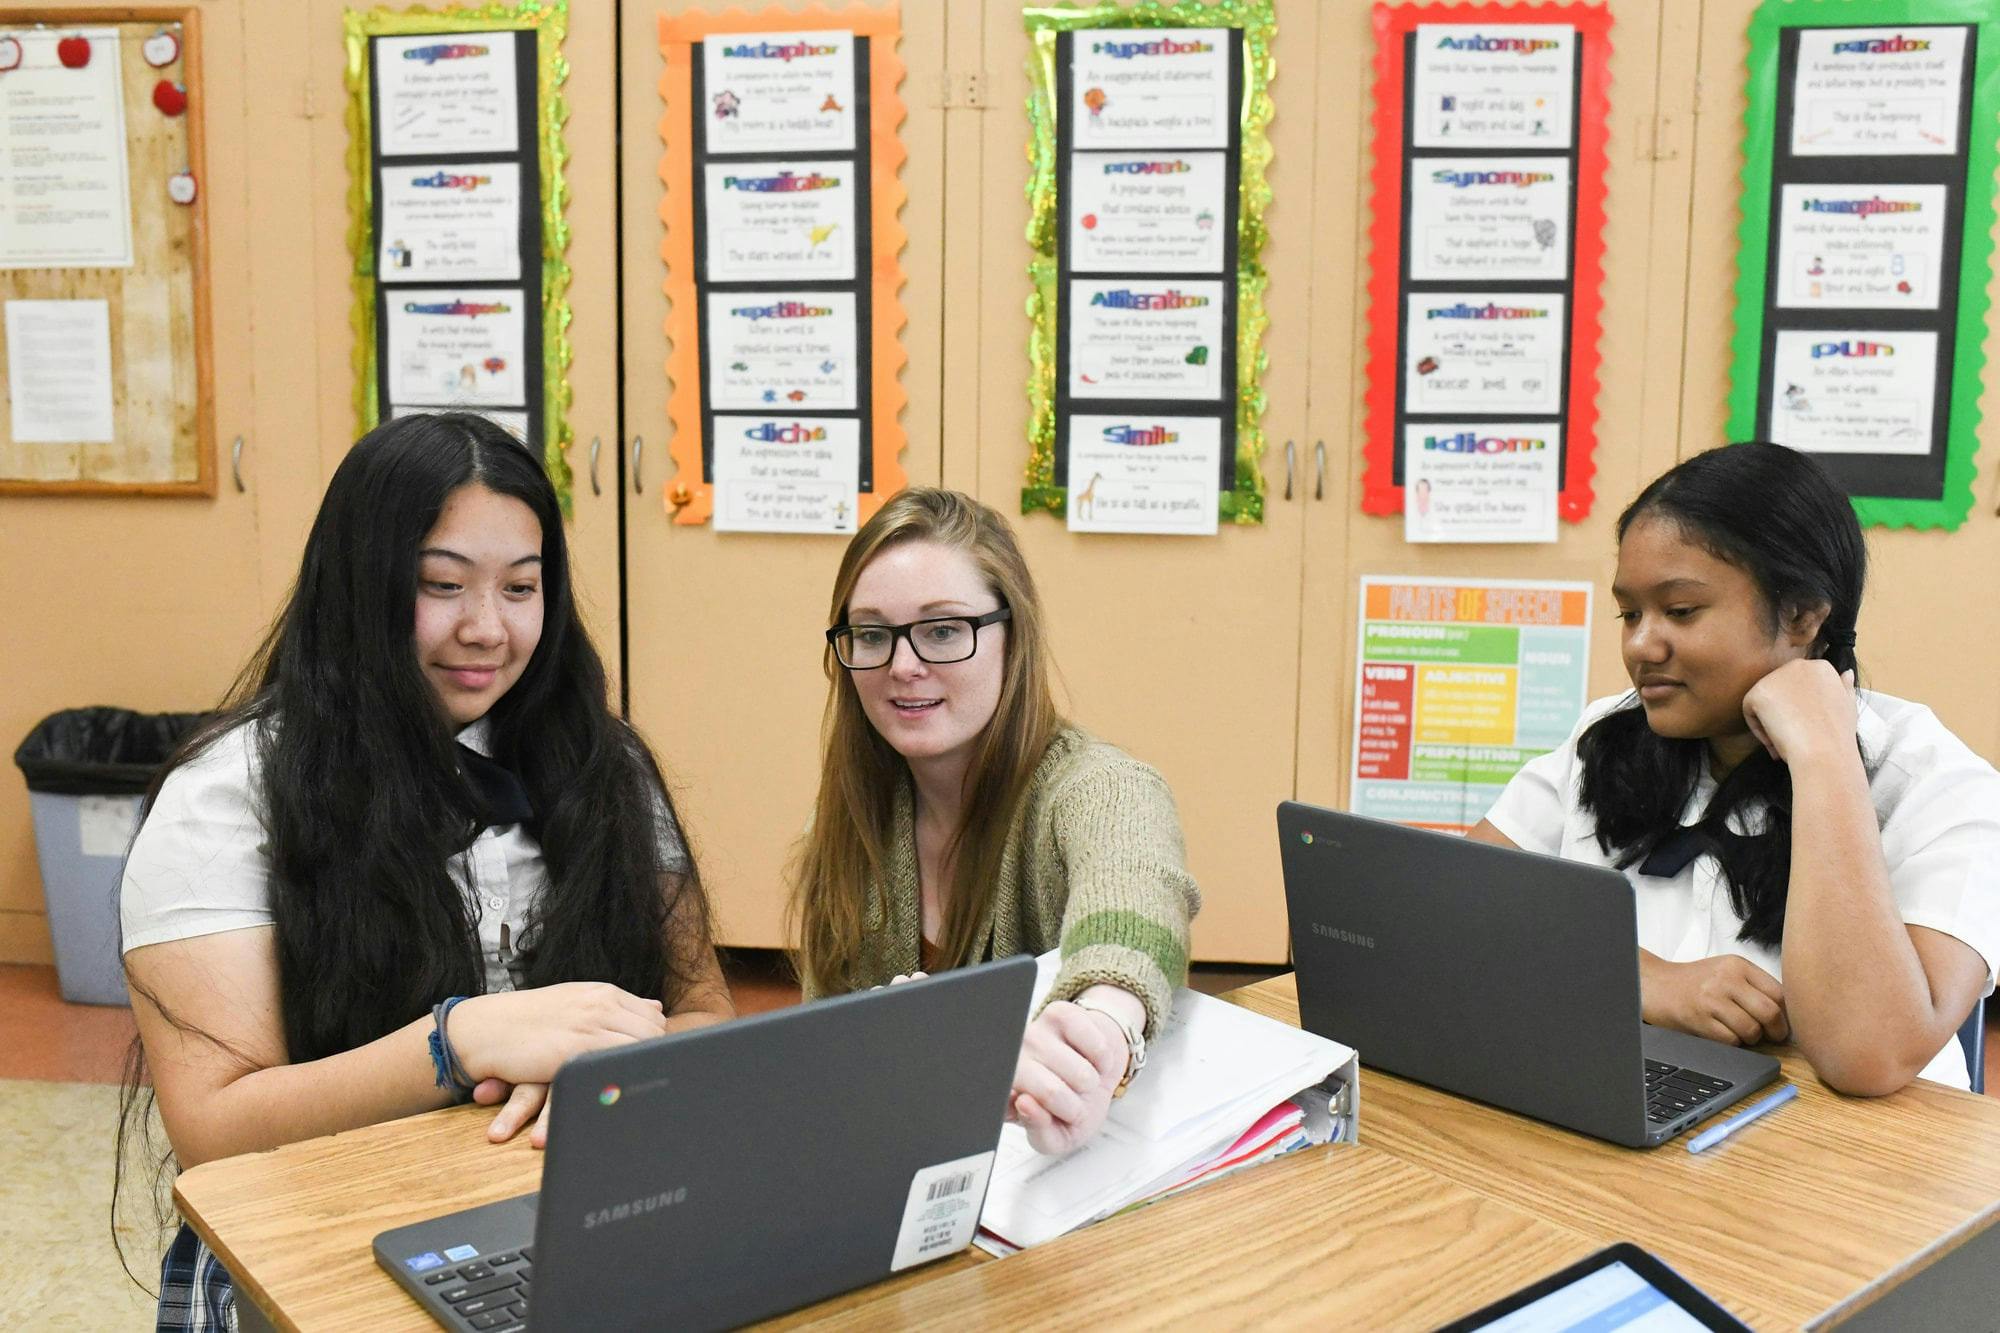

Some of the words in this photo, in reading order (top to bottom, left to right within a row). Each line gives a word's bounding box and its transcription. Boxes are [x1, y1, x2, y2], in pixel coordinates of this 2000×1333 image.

[723, 41, 839, 62] Metaphor
[1436, 34, 1559, 55] Antonym
[1833, 34, 1931, 54] paradox
[1104, 159, 1191, 175] proverb
[1432, 169, 1554, 188] Synonym
[1090, 289, 1209, 310] Alliteration
[731, 302, 833, 321] repetition
[1427, 302, 1548, 320] palindrome
[1811, 341, 1895, 359] pun
[1103, 425, 1179, 446] Simile
[1390, 586, 1456, 621] PARTS
[1458, 590, 1486, 621] OF
[1486, 591, 1562, 626] SPEECH
[1367, 625, 1446, 640] PRONOUN
[1524, 651, 1572, 664] NOUN
[1364, 666, 1407, 681] VERB
[1424, 670, 1507, 685] ADJECTIVE
[1416, 746, 1521, 761] PREPOSITION
[1312, 922, 1375, 949] SAMSUNG
[583, 1187, 688, 1229] SAMSUNG
